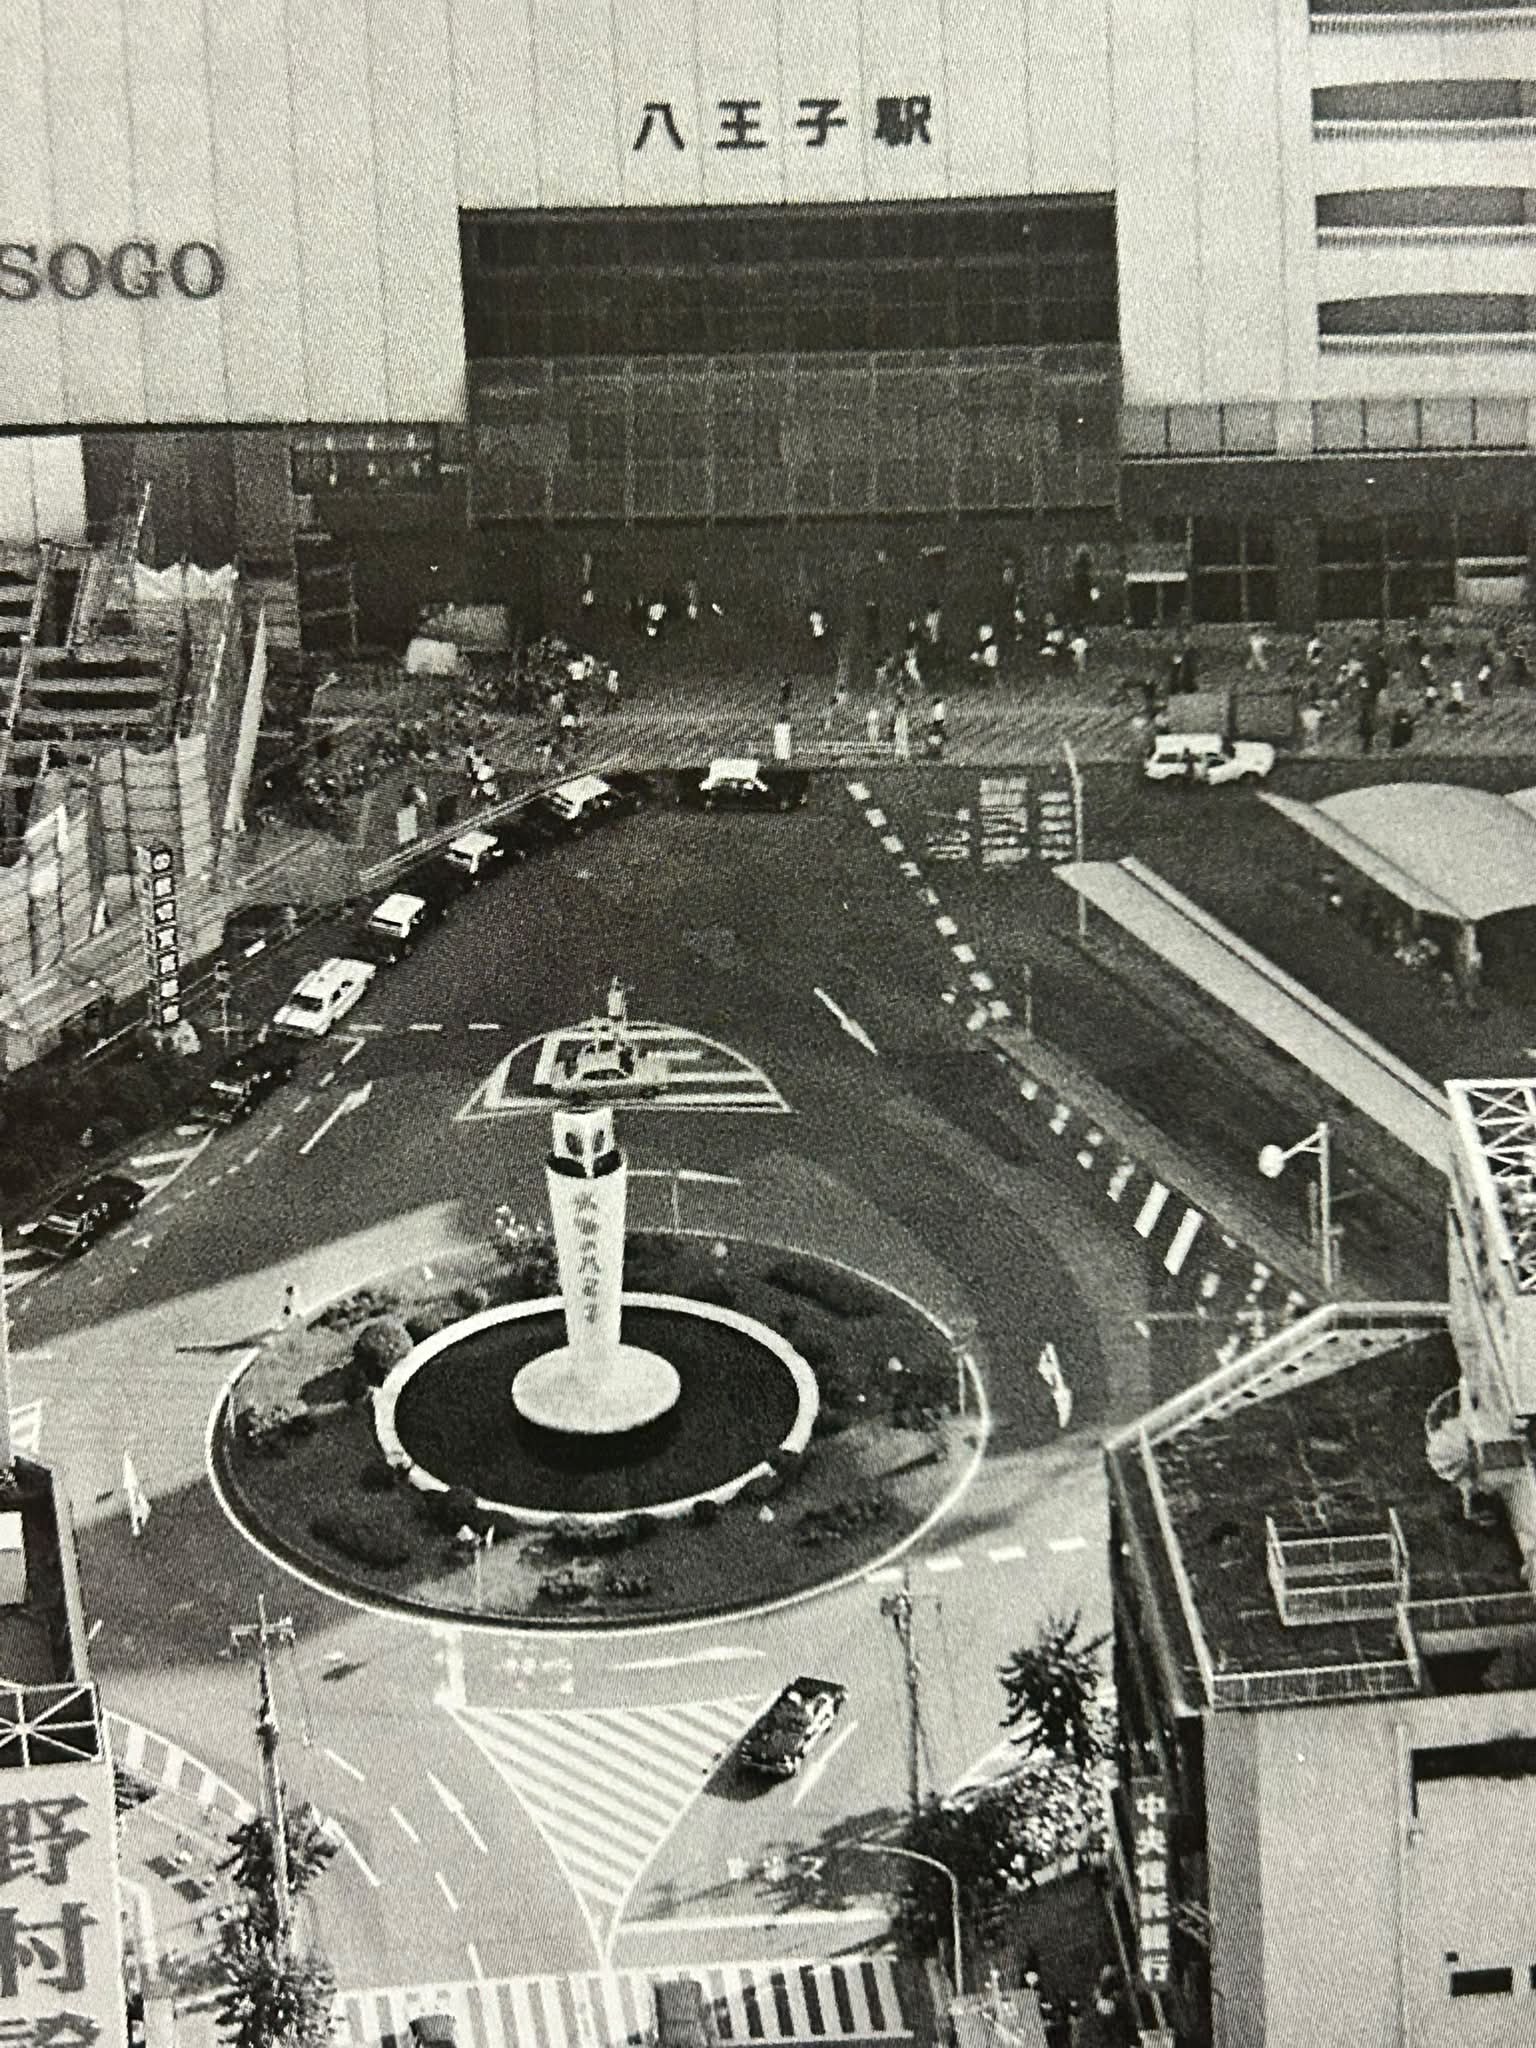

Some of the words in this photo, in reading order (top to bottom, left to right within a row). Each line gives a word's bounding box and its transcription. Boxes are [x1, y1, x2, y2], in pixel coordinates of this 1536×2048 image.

[632, 96, 932, 151] 八王子駅
[0, 241, 225, 301] SOGO
